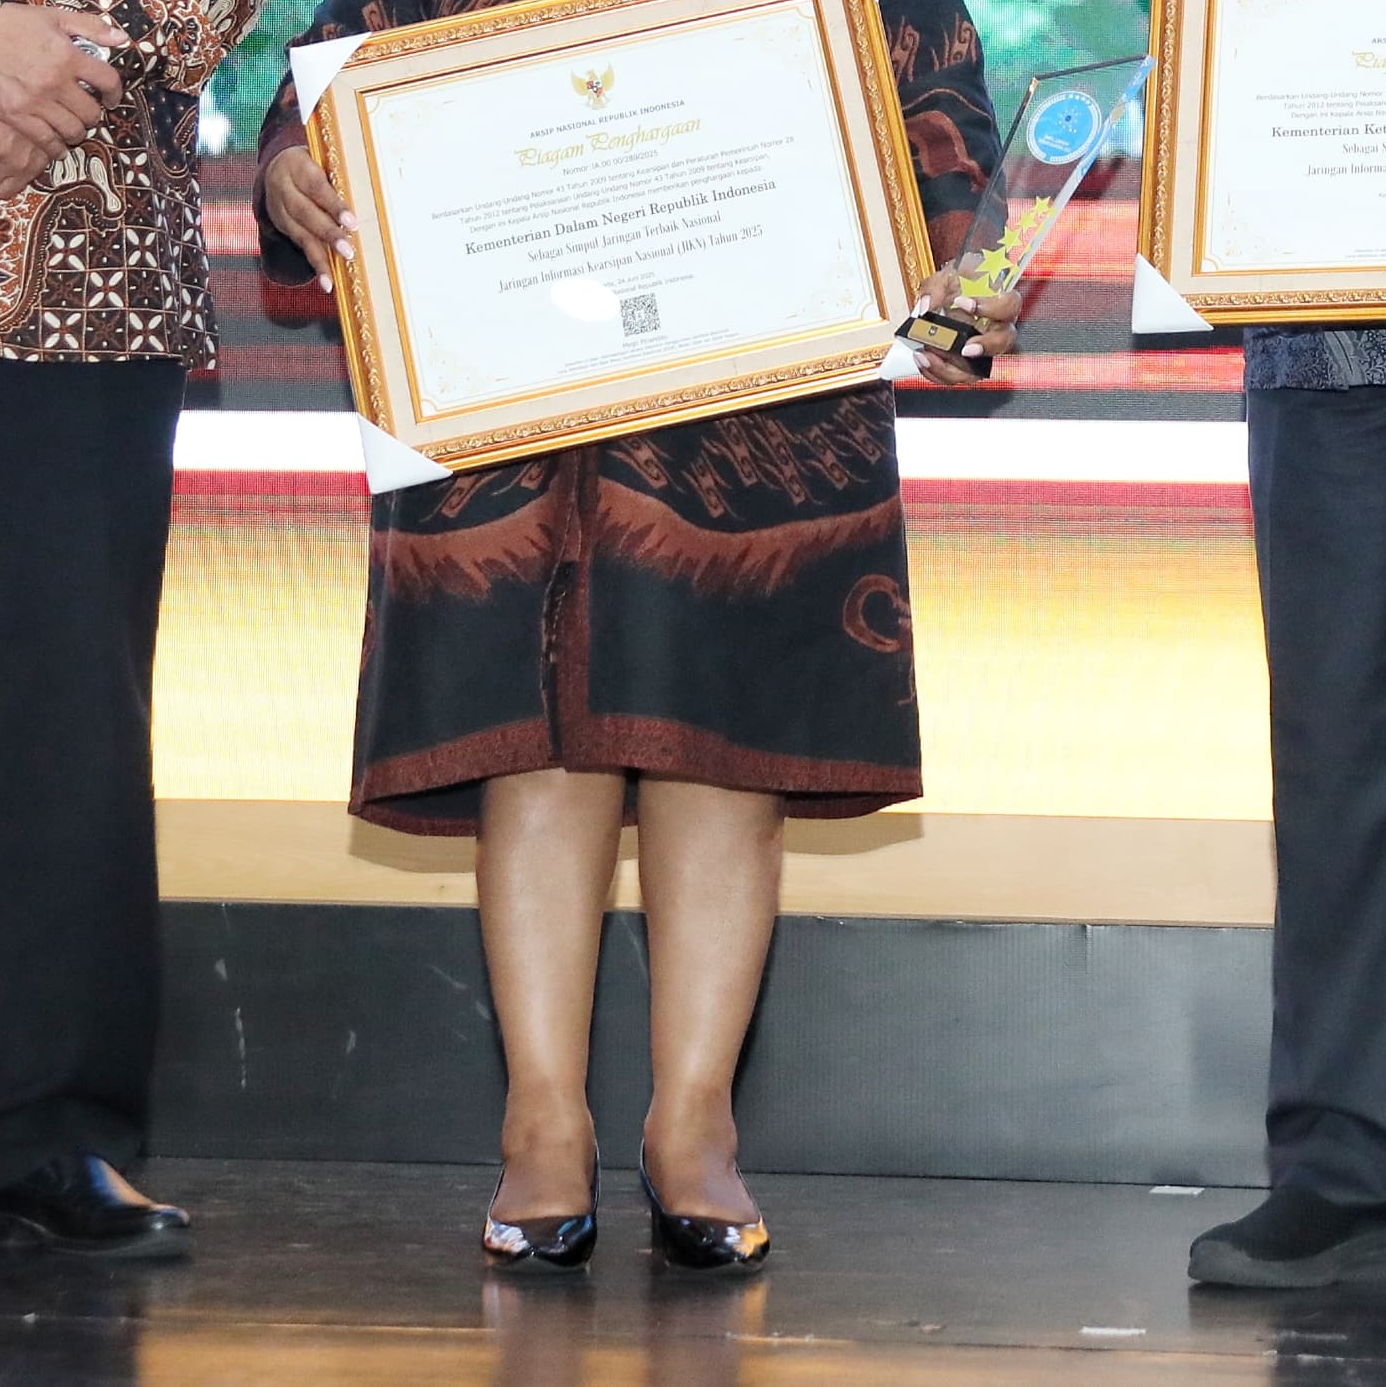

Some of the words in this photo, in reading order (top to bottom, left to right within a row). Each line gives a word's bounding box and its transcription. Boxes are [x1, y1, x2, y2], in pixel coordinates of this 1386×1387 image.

[513, 143, 584, 170] Piagam
[585, 119, 701, 154] Penghargaan
[530, 127, 555, 139] ARSIP
[556, 119, 597, 133] NASIONAL
[598, 109, 638, 124] REPUBLIK
[639, 99, 685, 115] INDONESIA
[1272, 125, 1359, 138] Kementerian
[465, 229, 551, 255] Kementerian
[554, 219, 599, 236] Dalam
[601, 205, 646, 226] Negeri
[649, 192, 709, 215] Republik
[712, 179, 776, 202] Indonesia
[527, 247, 564, 263] Sebagai
[565, 237, 599, 254] Simpul
[601, 230, 642, 248] Jaringan
[643, 219, 680, 238] Terbaik
[681, 210, 721, 229] Nasional
[498, 276, 539, 294] Jaringan
[540, 265, 585, 283] Informasi
[586, 255, 633, 273] Kearsipan
[634, 243, 675, 262] Nasional
[707, 232, 738, 247] Tahun
[739, 224, 763, 240] 2025
